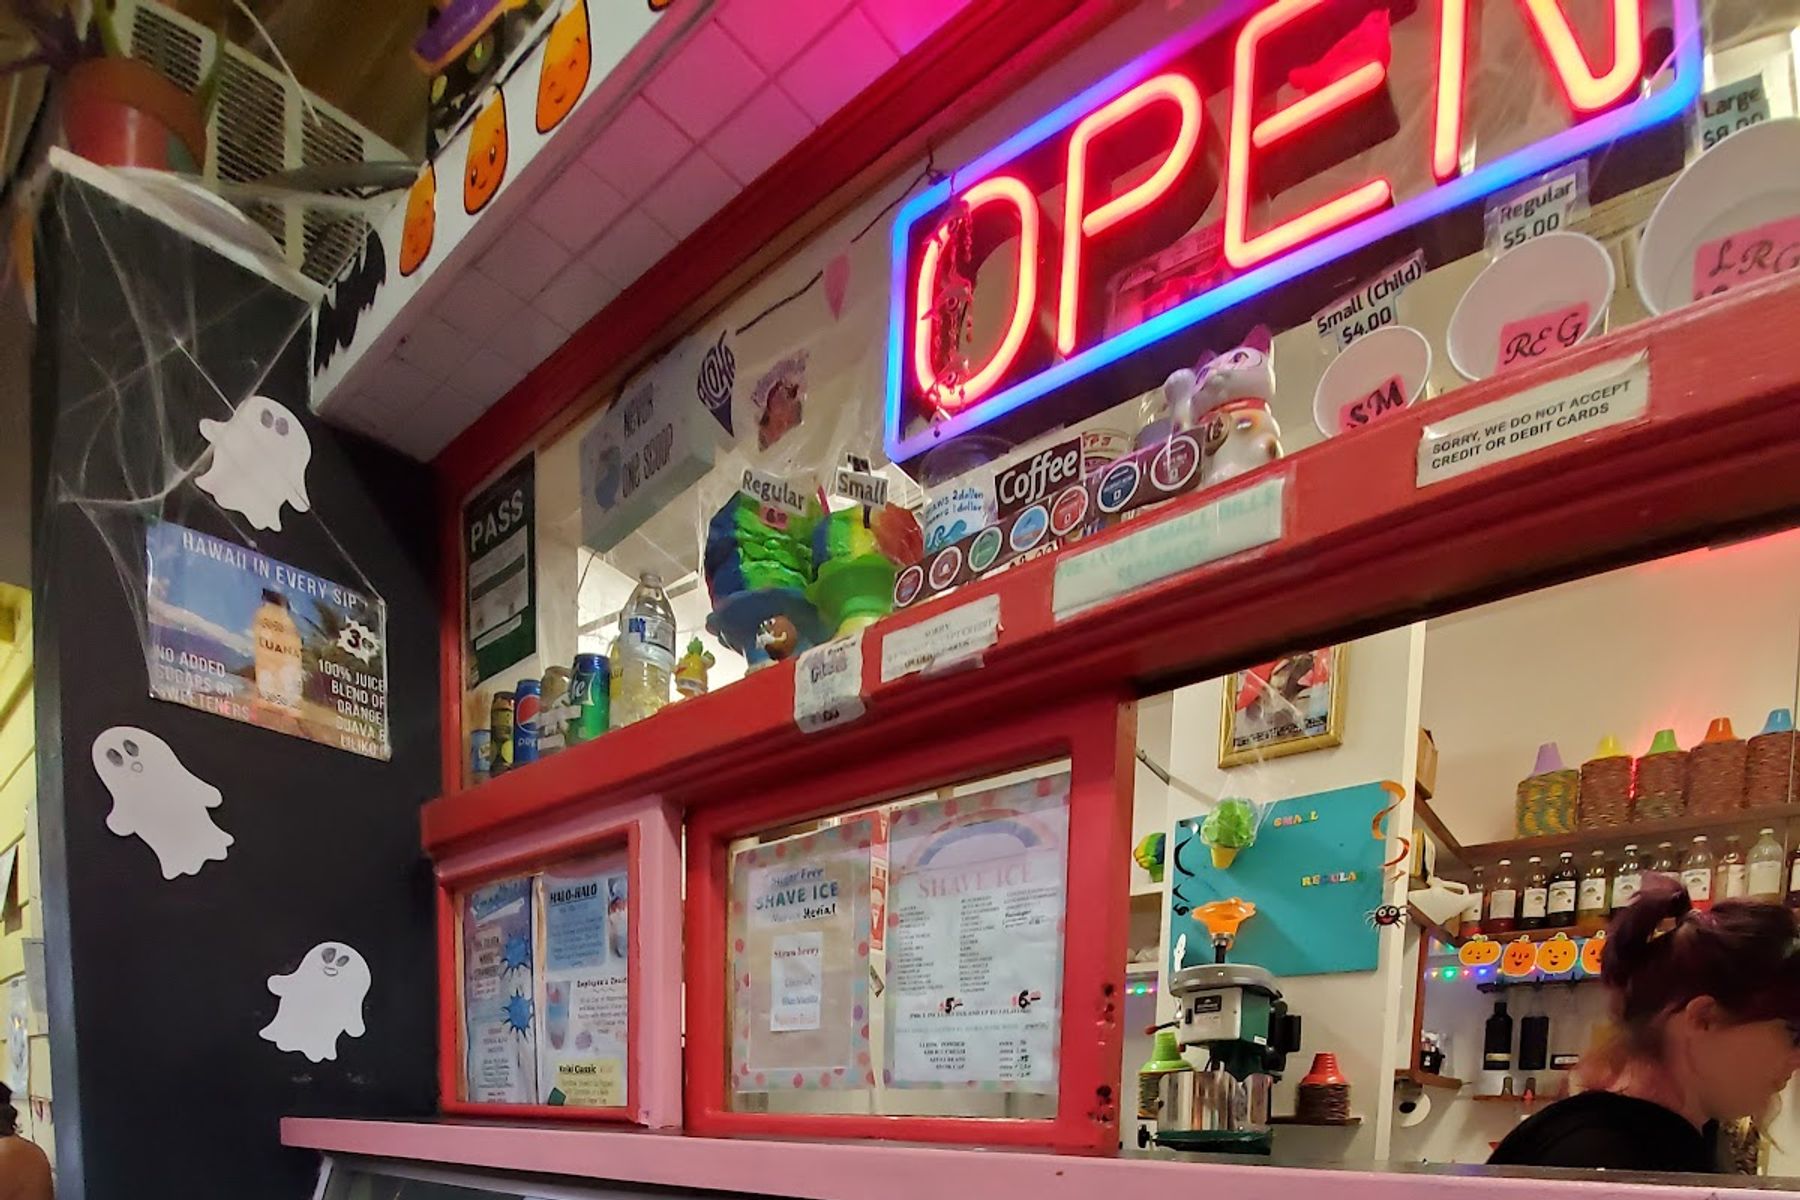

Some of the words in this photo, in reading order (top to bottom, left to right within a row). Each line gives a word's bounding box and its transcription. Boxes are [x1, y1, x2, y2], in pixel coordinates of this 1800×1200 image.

[1703, 87, 1760, 119] Large
[914, 0, 1645, 413] OPEN
[1500, 179, 1574, 224] Regular
[1502, 213, 1560, 249] $5.00
[1316, 286, 1363, 334] Small
[1366, 257, 1424, 308] (Child)
[1341, 306, 1393, 345] $4.00
[1346, 380, 1405, 428] SM
[1431, 430, 1482, 455] SORRY,
[1484, 417, 1508, 437] WE
[1509, 411, 1532, 429] DO
[1535, 401, 1567, 421] NOT
[1568, 379, 1632, 413] ACCEPT
[1431, 444, 1481, 470] CREDIT
[1485, 434, 1508, 452] OR
[1509, 420, 1552, 446] DEBIT
[1556, 402, 1610, 429] CARDS
[742, 470, 806, 511] Regular
[837, 473, 888, 506] Small
[998, 446, 1079, 505] Coffee
[471, 489, 524, 553] PASS
[182, 532, 247, 571] HAWAII
[253, 557, 271, 579] IN
[275, 566, 328, 598] EVERY
[332, 588, 358, 608] SIP
[179, 651, 226, 678] ADDED
[318, 659, 352, 682] 100%
[355, 671, 385, 693] JUICE
[331, 679, 369, 705] BLEND
[335, 715, 377, 740] GUAVA
[549, 883, 597, 904] HALO-HALO
[756, 887, 807, 911] SHAVE
[812, 881, 839, 900] ICE
[574, 1063, 597, 1075] Classic
